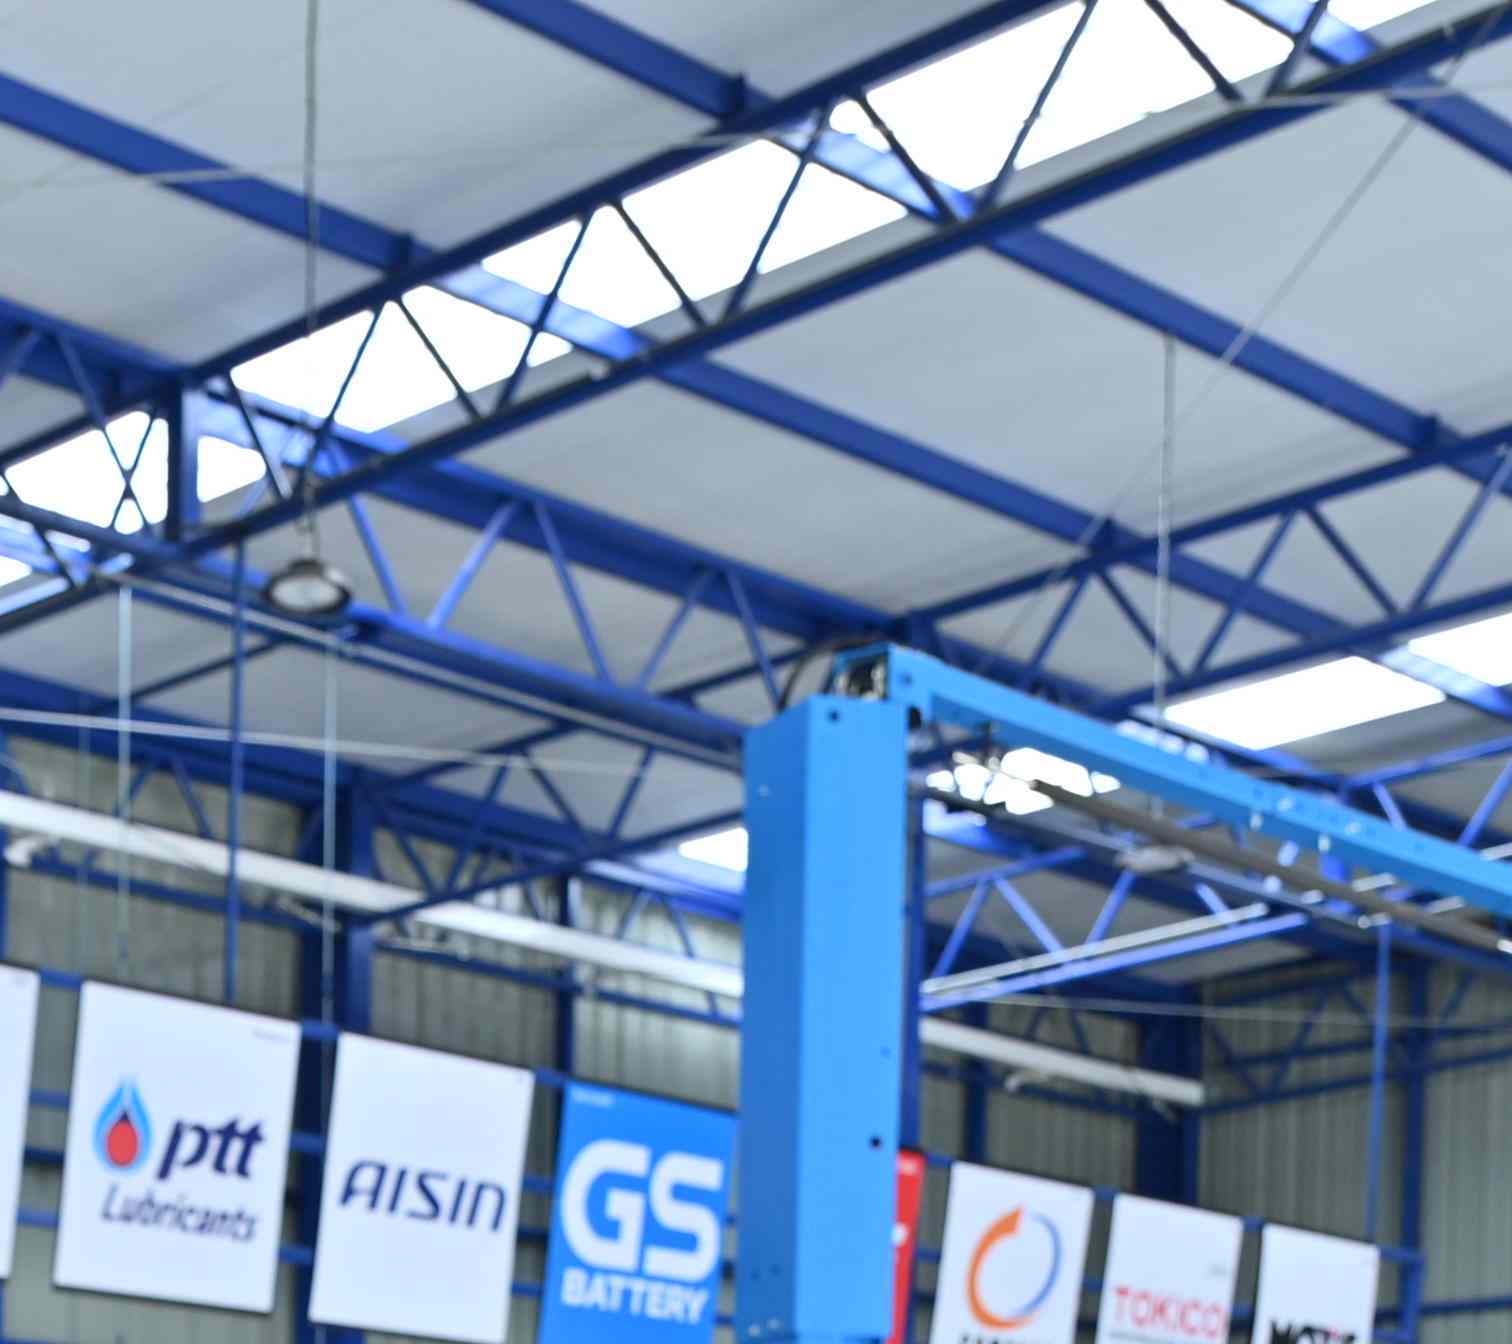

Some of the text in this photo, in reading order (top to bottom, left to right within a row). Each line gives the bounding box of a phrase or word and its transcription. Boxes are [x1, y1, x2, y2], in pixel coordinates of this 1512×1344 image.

[155, 1114, 266, 1181] ptt
[101, 1183, 259, 1243] Lubricants
[338, 1159, 507, 1234] AISIN
[560, 1138, 724, 1282] GS
[561, 1266, 709, 1325] BATTERY
[1112, 1286, 1229, 1340] TOKICO
